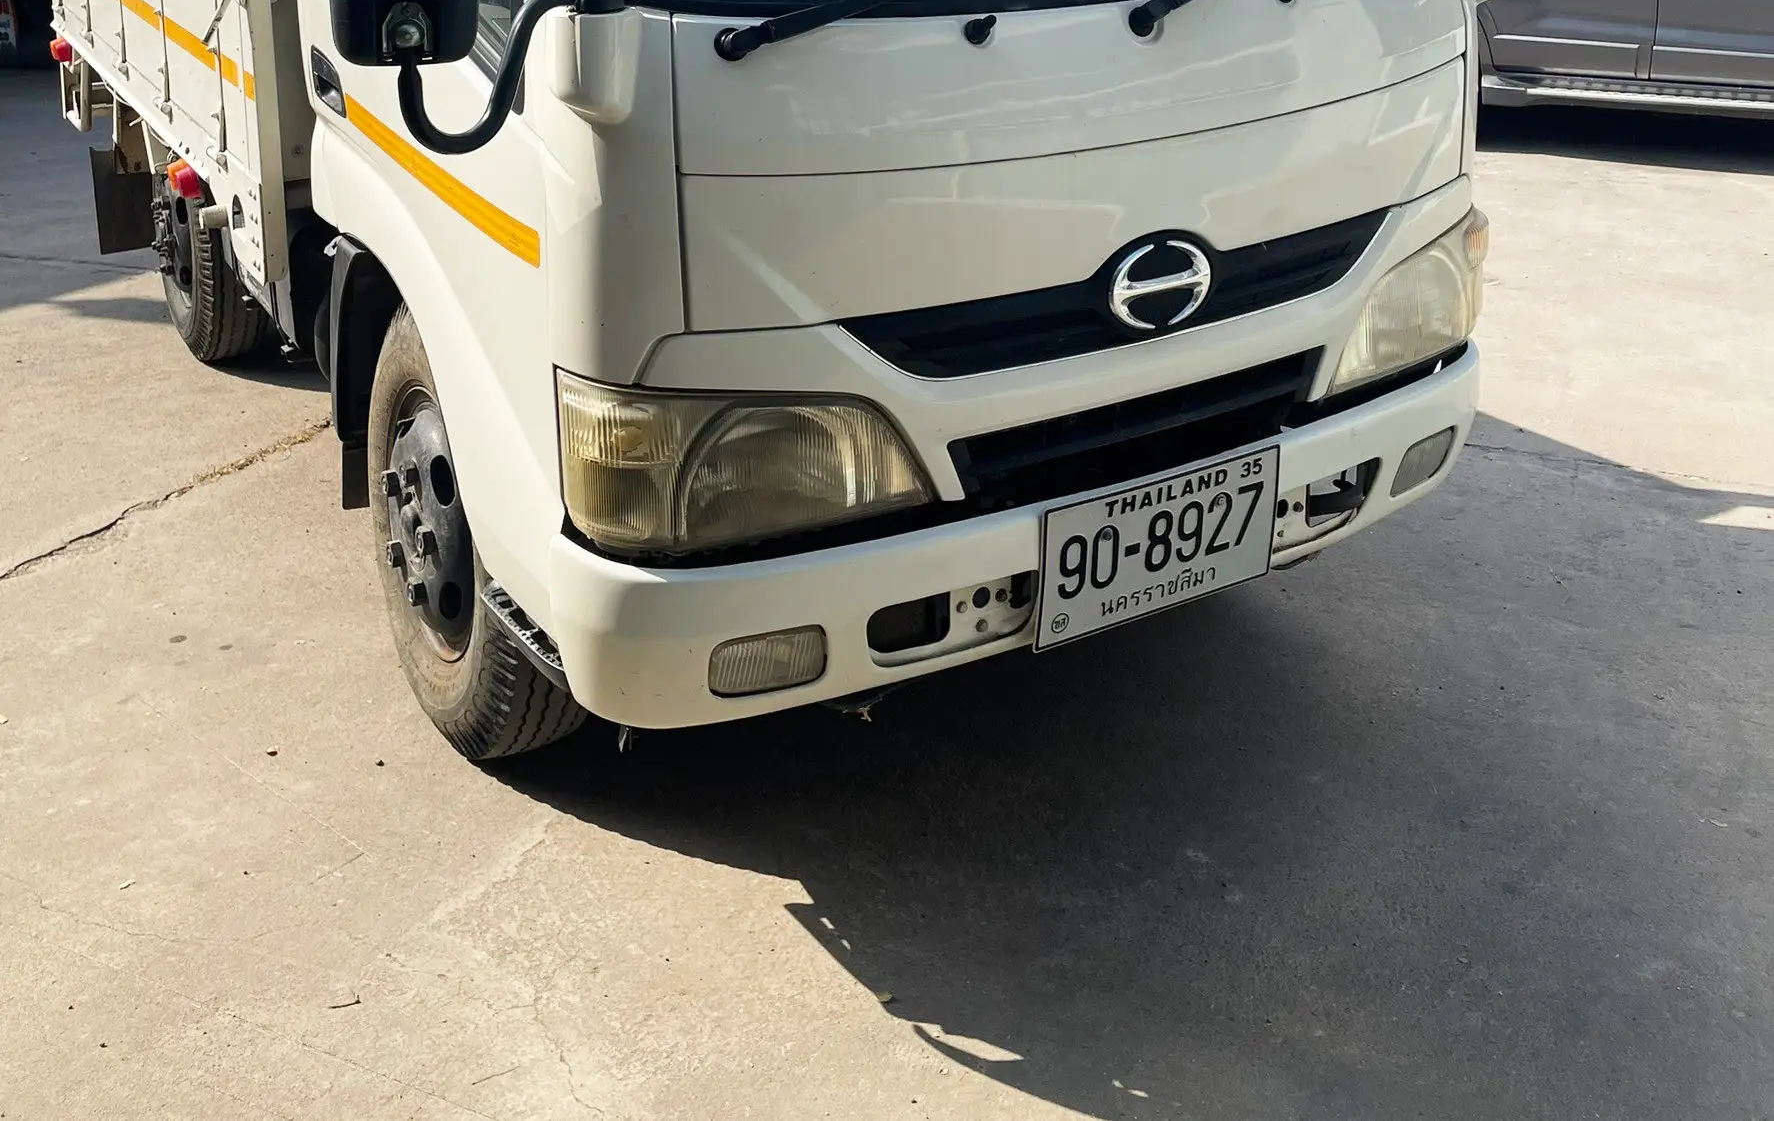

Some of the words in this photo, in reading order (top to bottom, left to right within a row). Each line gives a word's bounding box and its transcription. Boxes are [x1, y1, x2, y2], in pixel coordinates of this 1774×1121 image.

[1105, 468, 1228, 518] THAILAND
[1240, 457, 1264, 479] 35
[1057, 480, 1265, 600] 90-8927
[1101, 566, 1217, 617] นครราชสีมา
